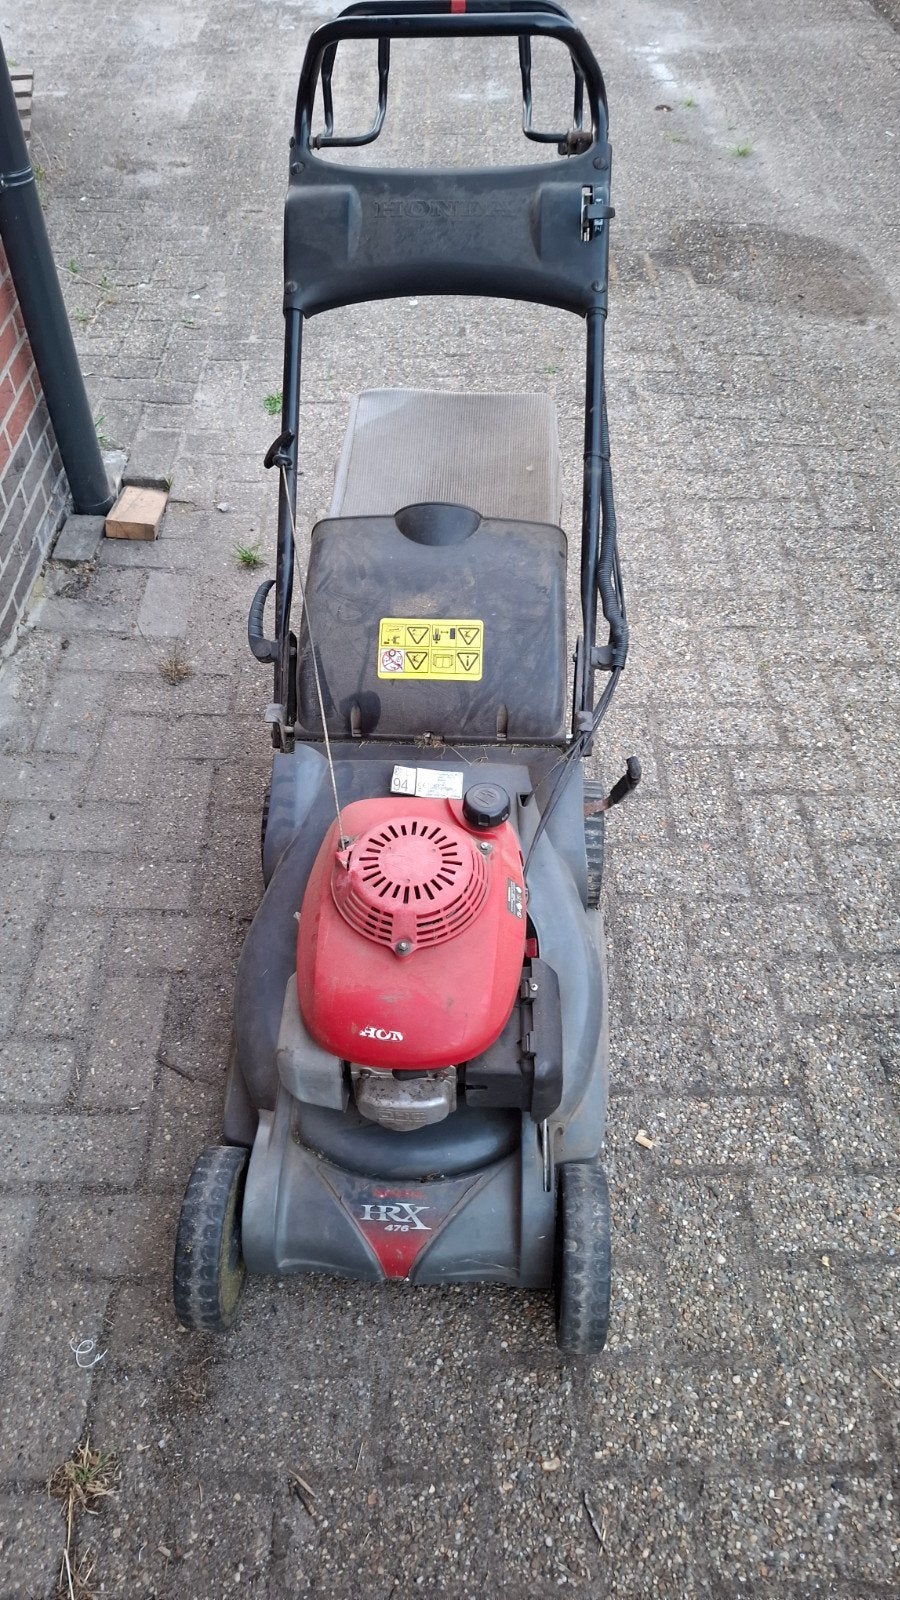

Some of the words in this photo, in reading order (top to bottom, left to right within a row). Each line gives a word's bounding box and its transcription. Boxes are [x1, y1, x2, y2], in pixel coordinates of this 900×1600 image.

[373, 199, 519, 219] HONDA
[393, 777, 409, 791] 94
[360, 1202, 432, 1230] HRX
[384, 1224, 410, 1232] 476
